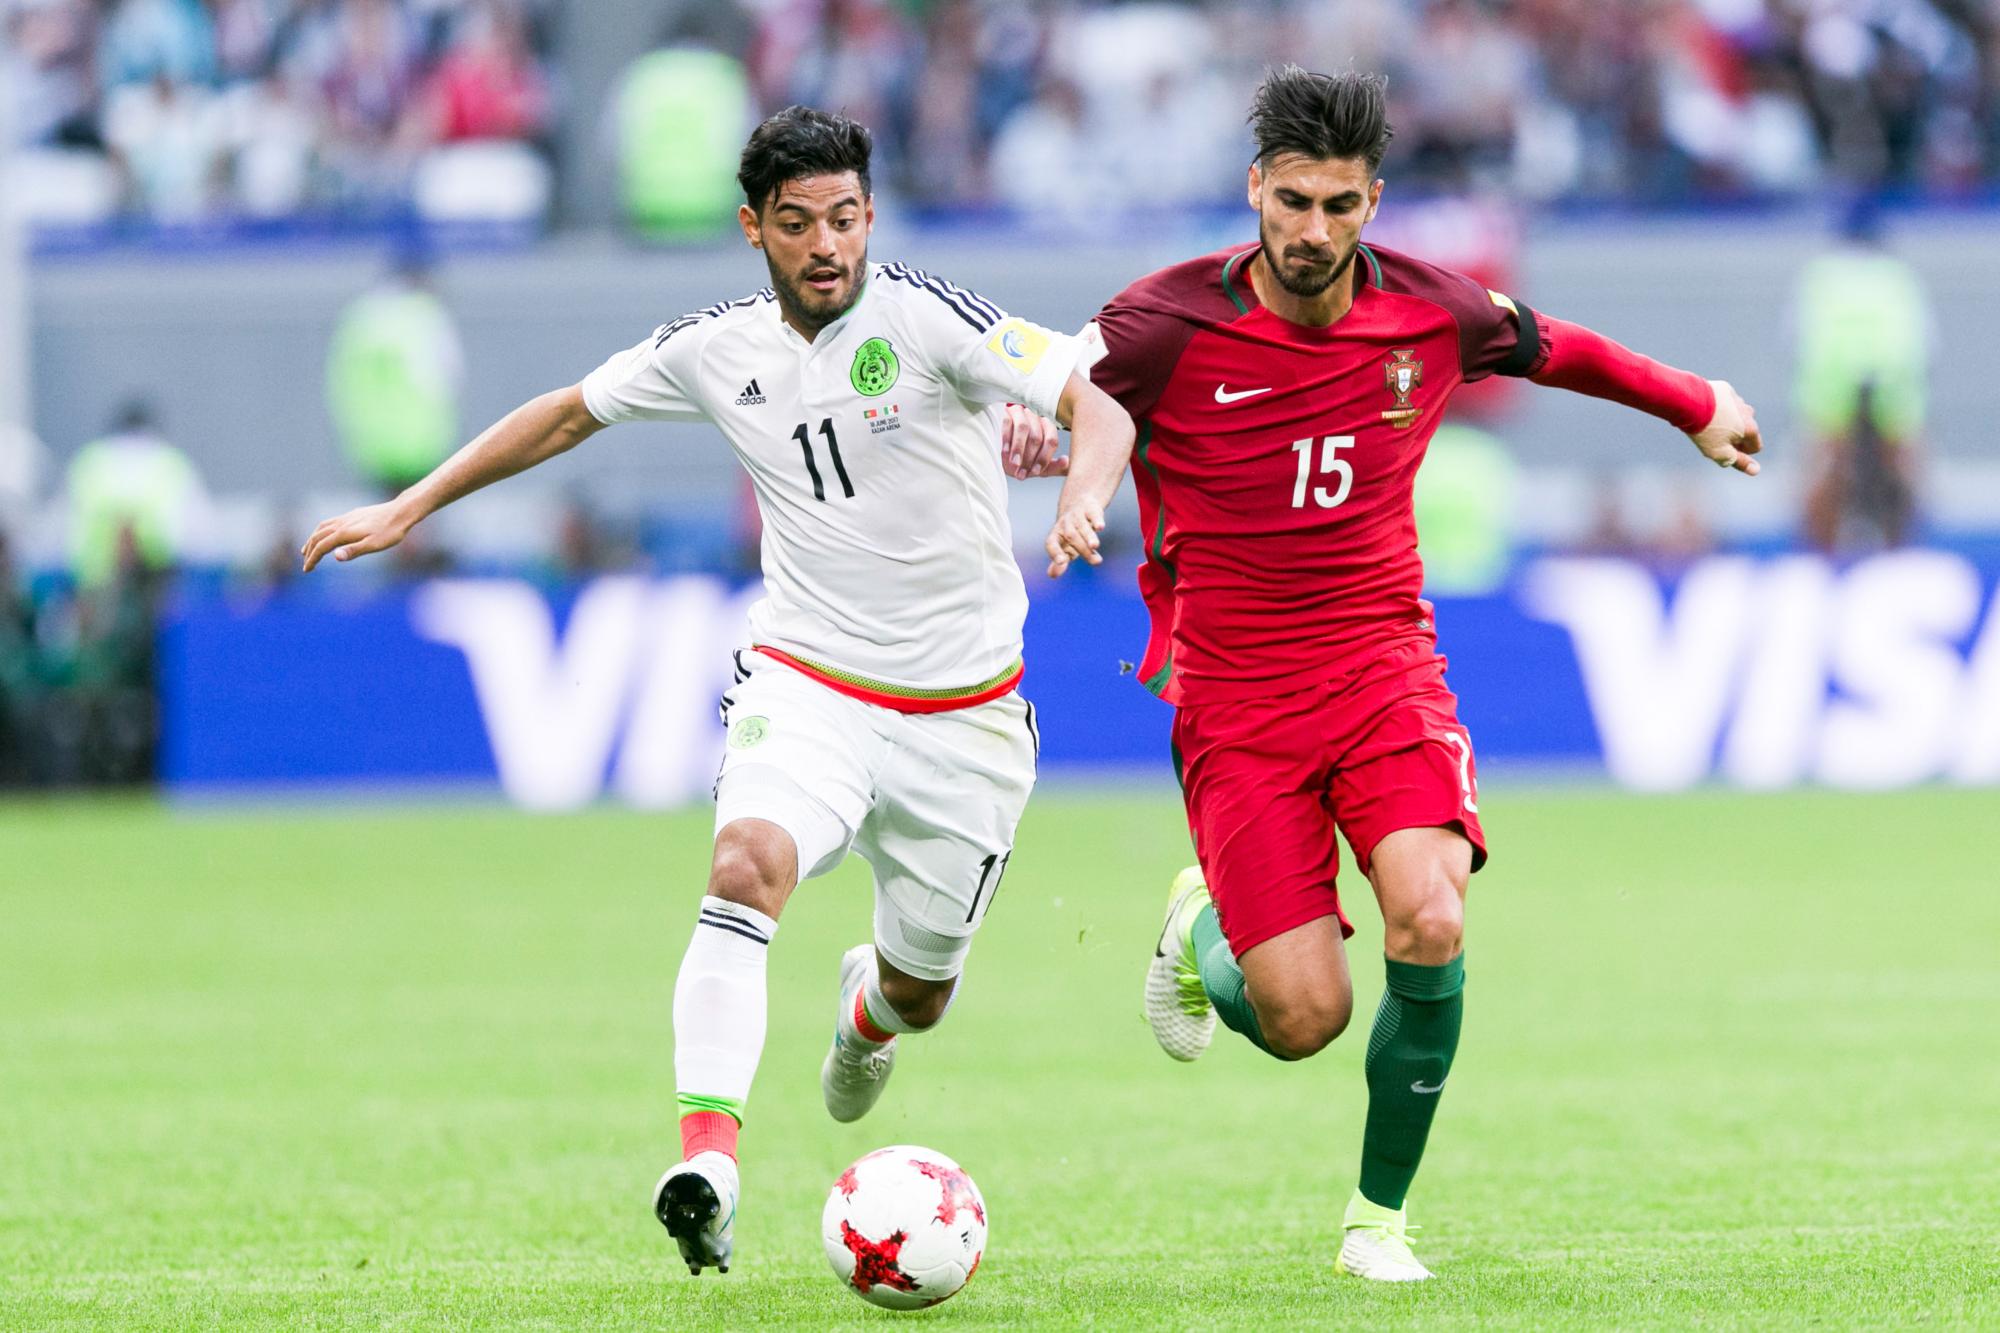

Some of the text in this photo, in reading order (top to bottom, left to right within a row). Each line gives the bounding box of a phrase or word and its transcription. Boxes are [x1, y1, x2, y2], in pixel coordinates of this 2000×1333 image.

[735, 395, 767, 406] adidas
[791, 417, 855, 502] 11
[1291, 435, 1356, 509] 15
[408, 573, 758, 812] VI
